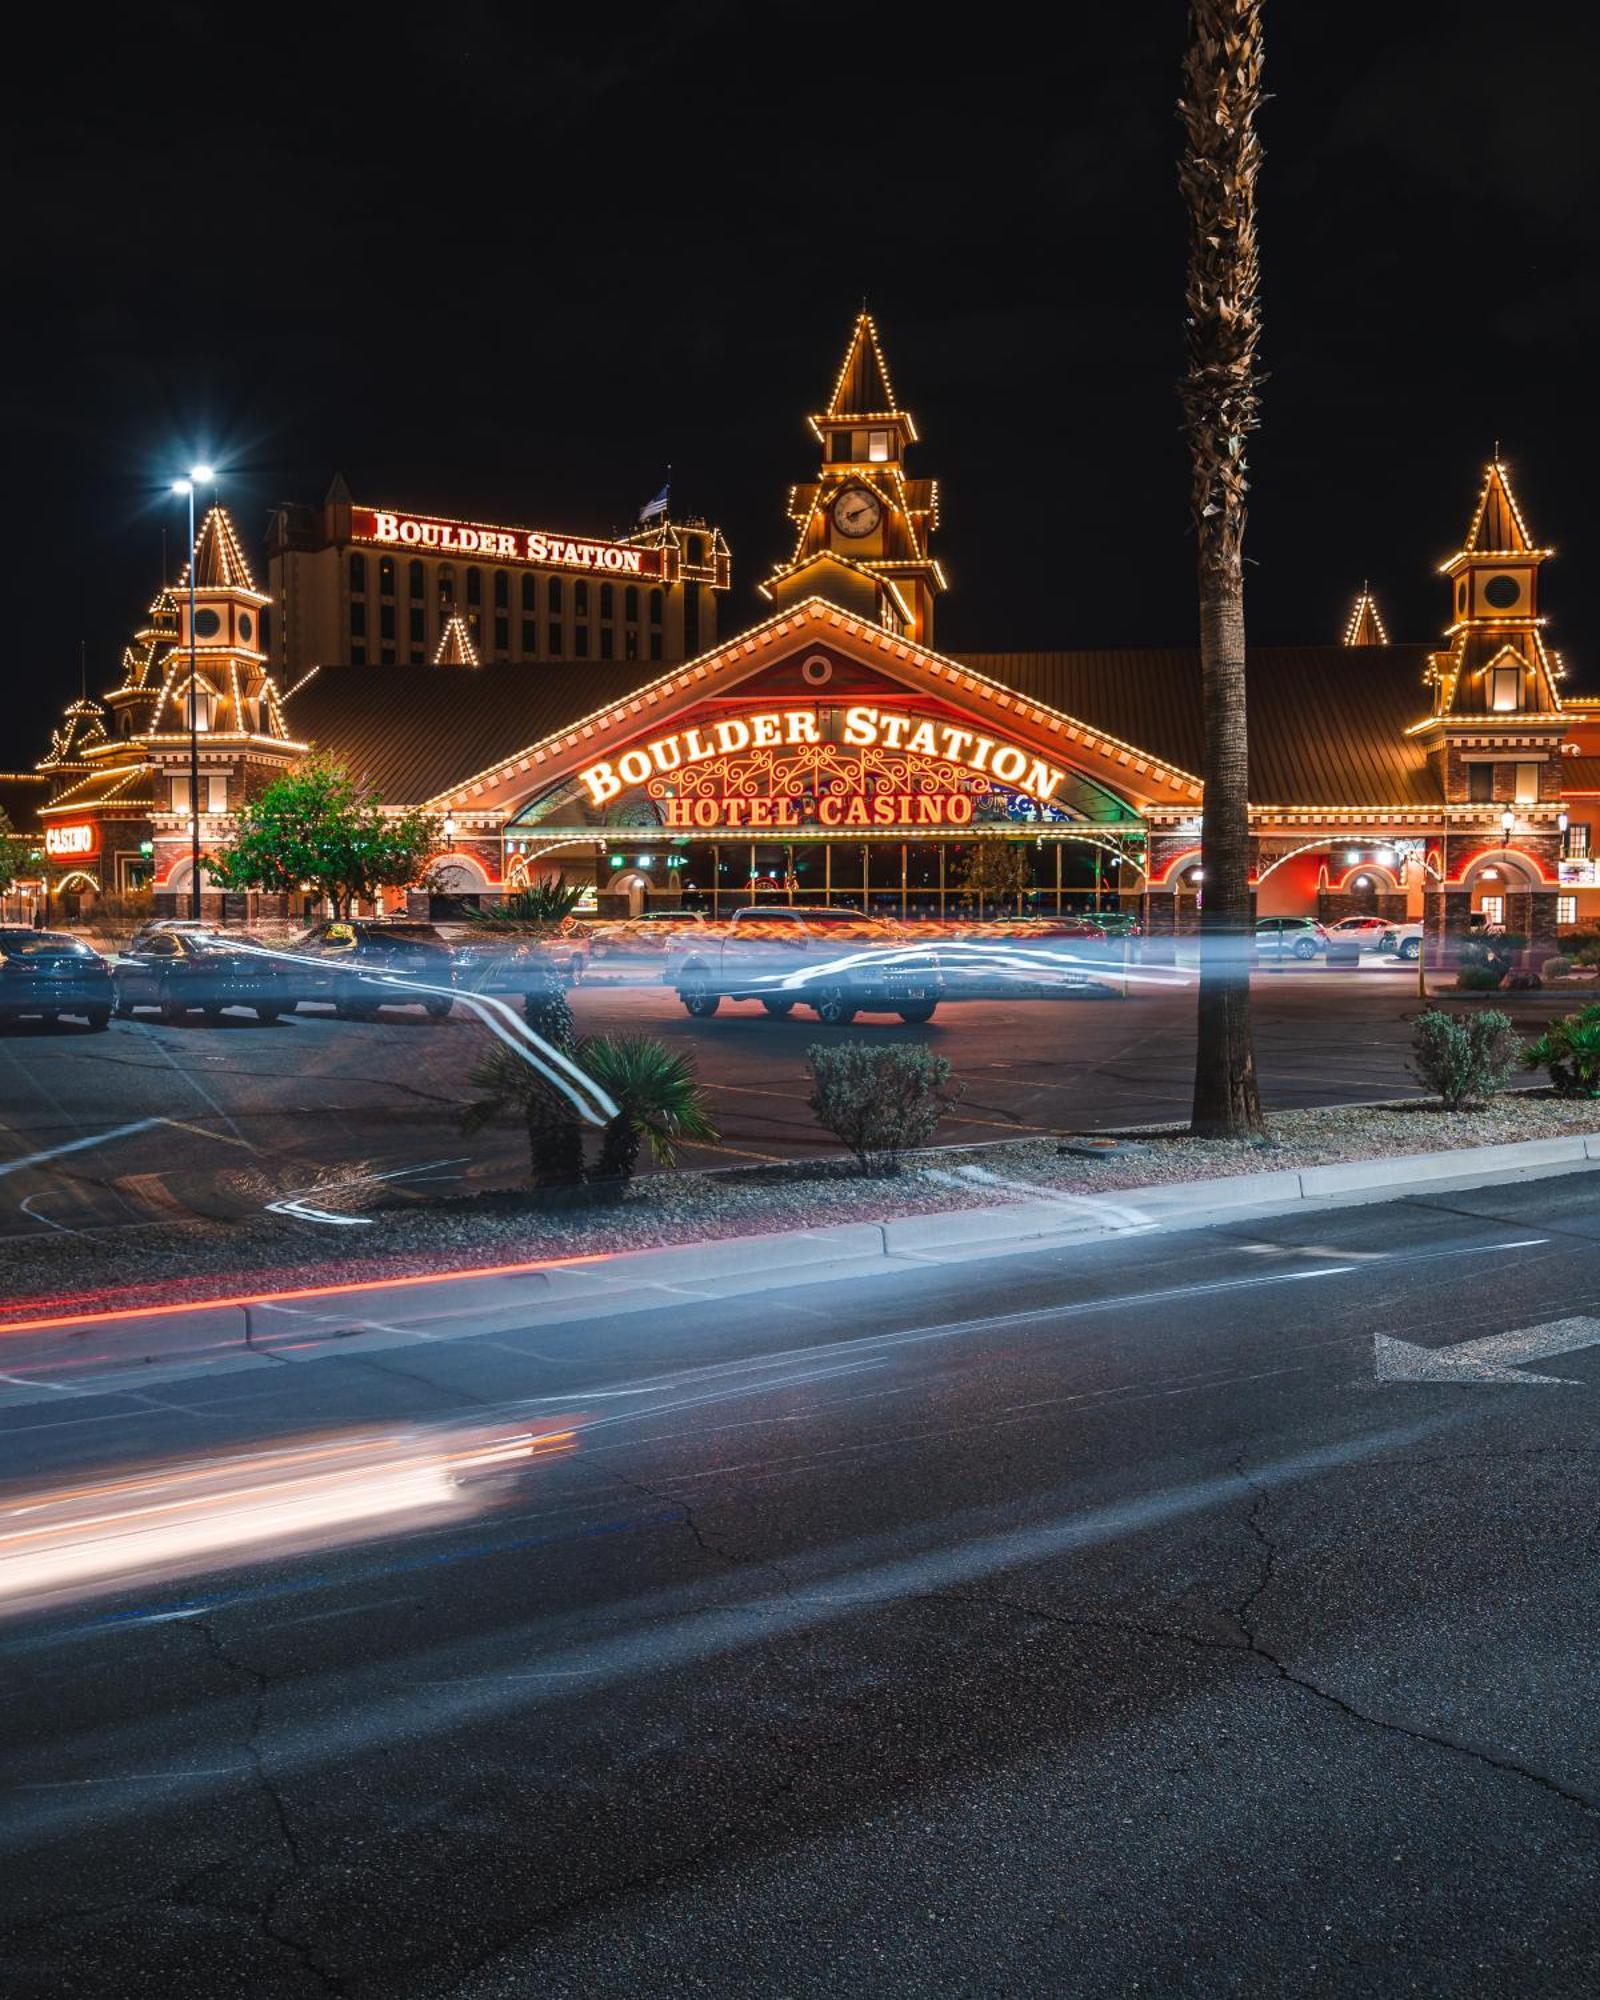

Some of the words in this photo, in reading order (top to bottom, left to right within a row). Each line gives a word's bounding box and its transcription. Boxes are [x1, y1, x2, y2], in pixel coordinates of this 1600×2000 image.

[375, 513, 517, 556] BOULDER
[527, 534, 640, 571] STATION
[579, 711, 820, 806] BOULDER
[844, 707, 1064, 799] STATION
[667, 797, 799, 826] HOTEL
[819, 795, 974, 826] CASINO
[46, 825, 92, 854] CASINO
